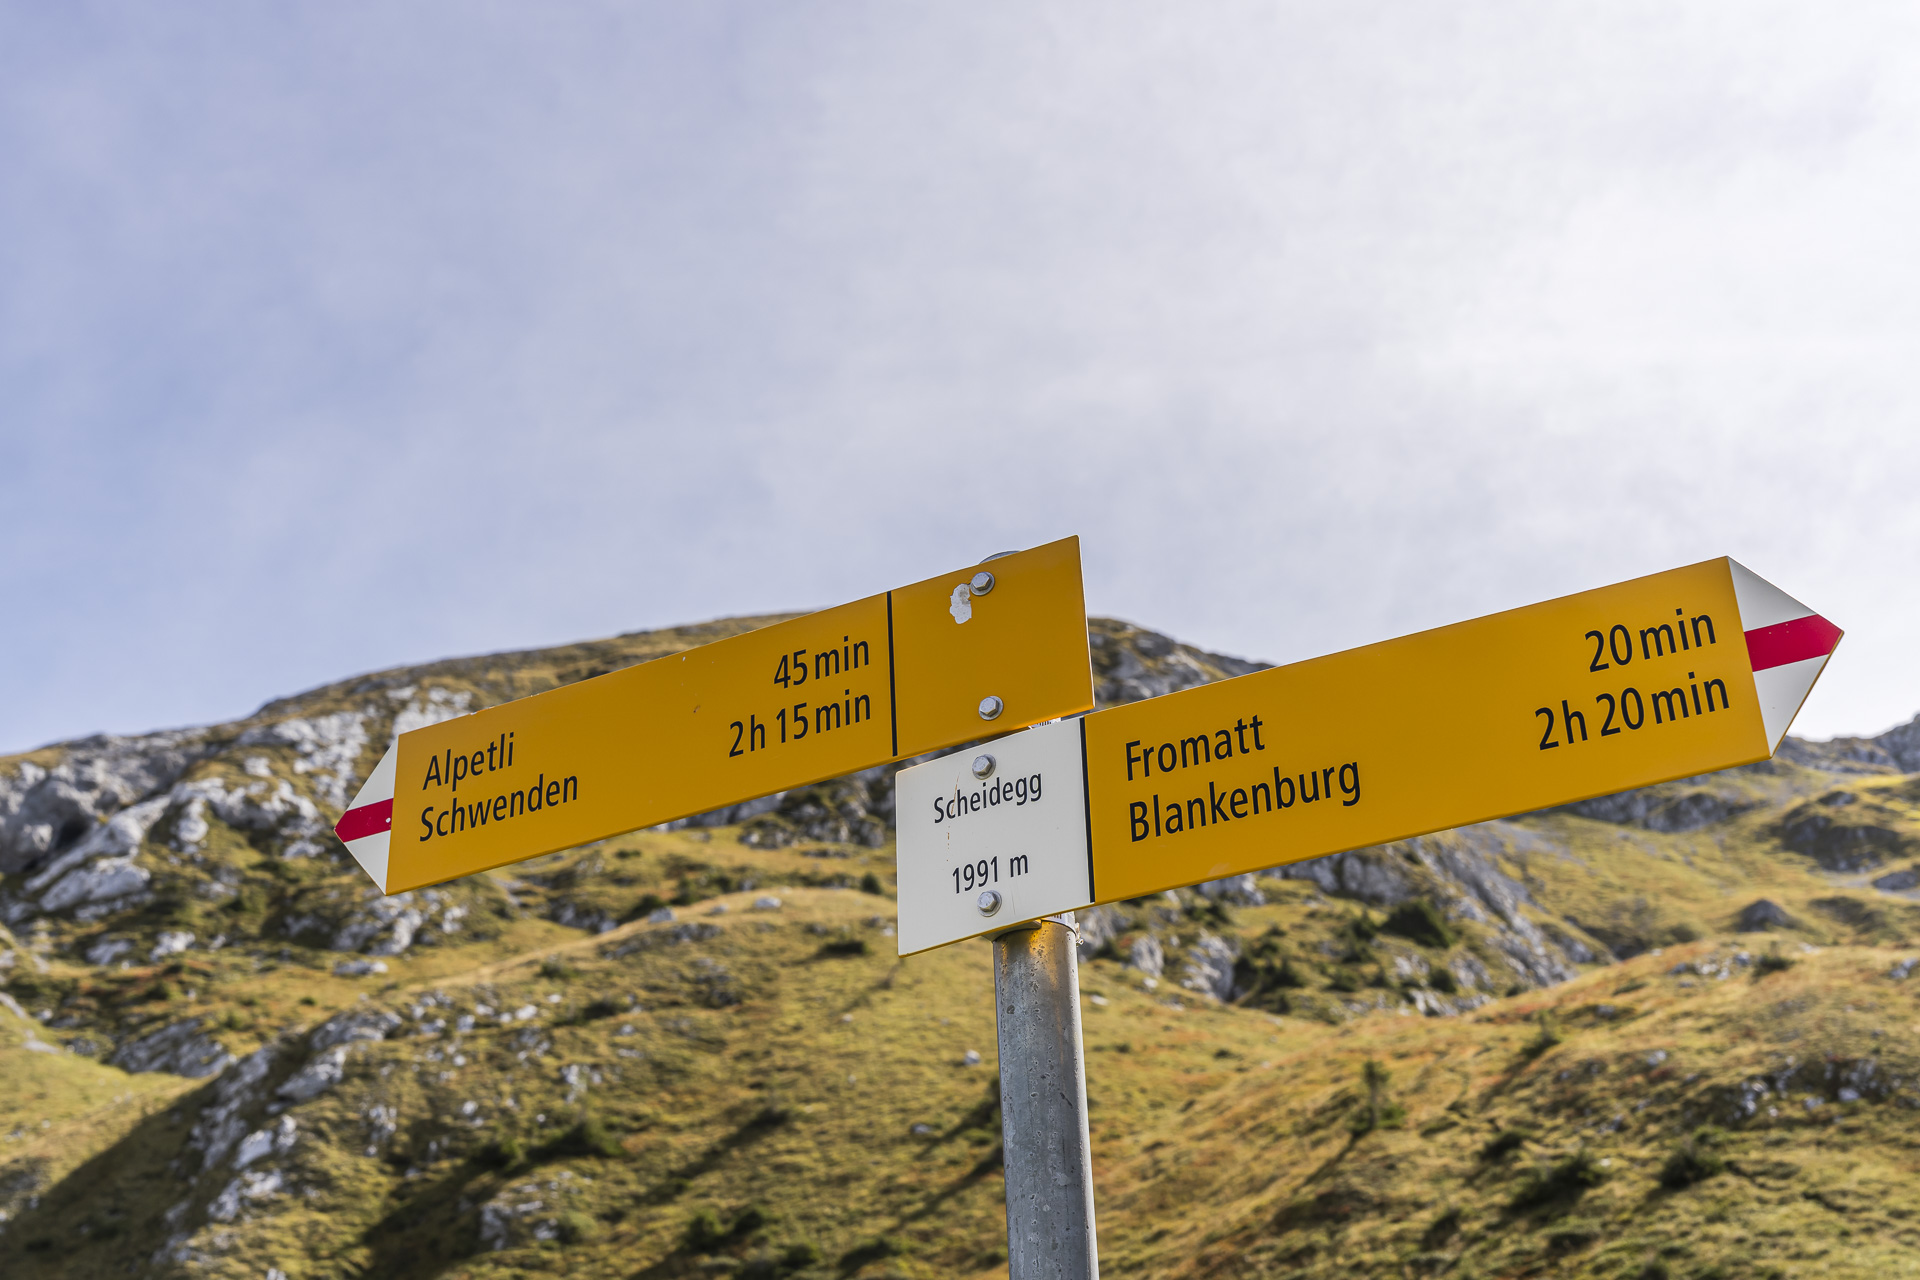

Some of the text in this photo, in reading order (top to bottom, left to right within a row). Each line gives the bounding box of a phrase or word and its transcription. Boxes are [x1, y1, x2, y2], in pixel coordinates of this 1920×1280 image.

[422, 731, 515, 793] Alpetli
[1125, 714, 1266, 782] Fromatt
[419, 773, 578, 842] Schwenden
[933, 773, 1042, 824] Scheidegg
[1129, 761, 1361, 843] Blankenburg
[952, 854, 1029, 894] 1991 m
